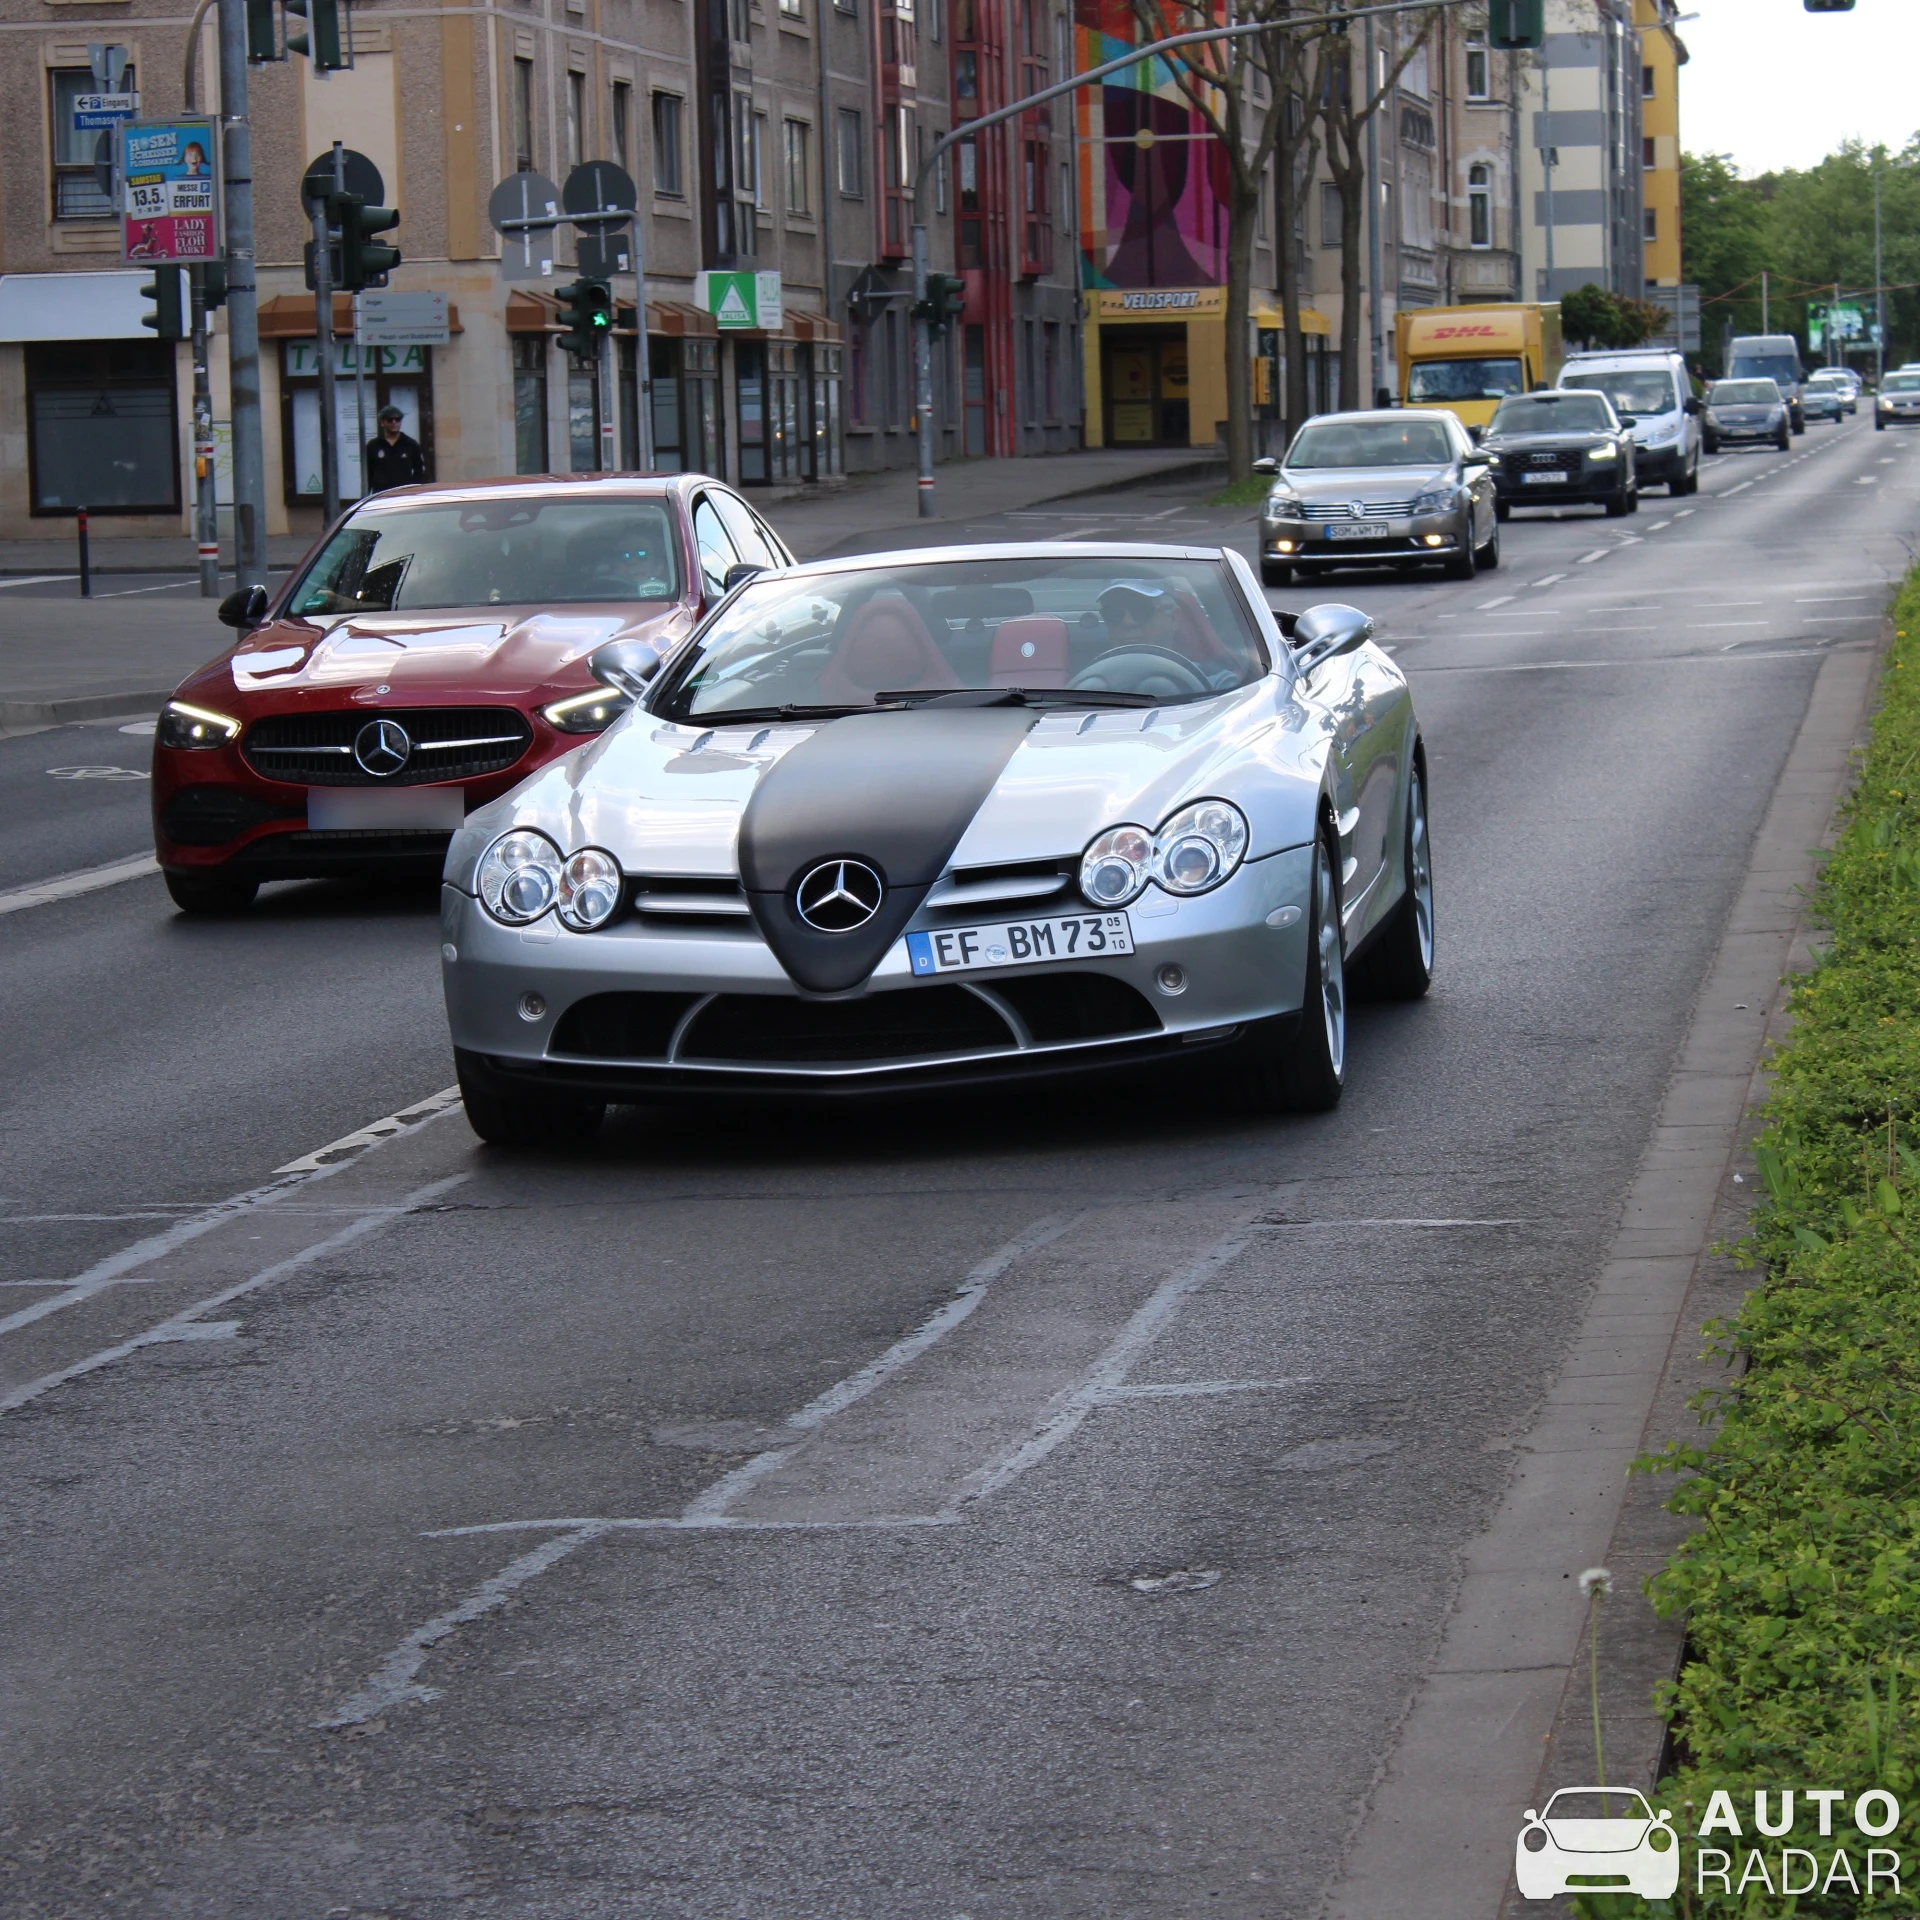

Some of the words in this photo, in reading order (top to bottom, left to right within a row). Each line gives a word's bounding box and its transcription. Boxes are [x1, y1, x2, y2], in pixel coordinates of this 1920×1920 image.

[102, 98, 129, 108] Eingang
[131, 174, 161, 186] SAMSTAG
[177, 184, 198, 193] MESSE
[132, 188, 164, 206] 13.5.
[173, 195, 211, 208] ERFURT
[174, 219, 206, 230] LADY
[175, 235, 205, 248] FLOH
[1122, 291, 1199, 309] VELOSPORT
[1433, 326, 1495, 339] DHL
[291, 343, 424, 370] TLISA
[1106, 916, 1121, 928] 05
[918, 956, 928, 968] D
[934, 930, 979, 967] EF
[1111, 939, 1126, 950] 10
